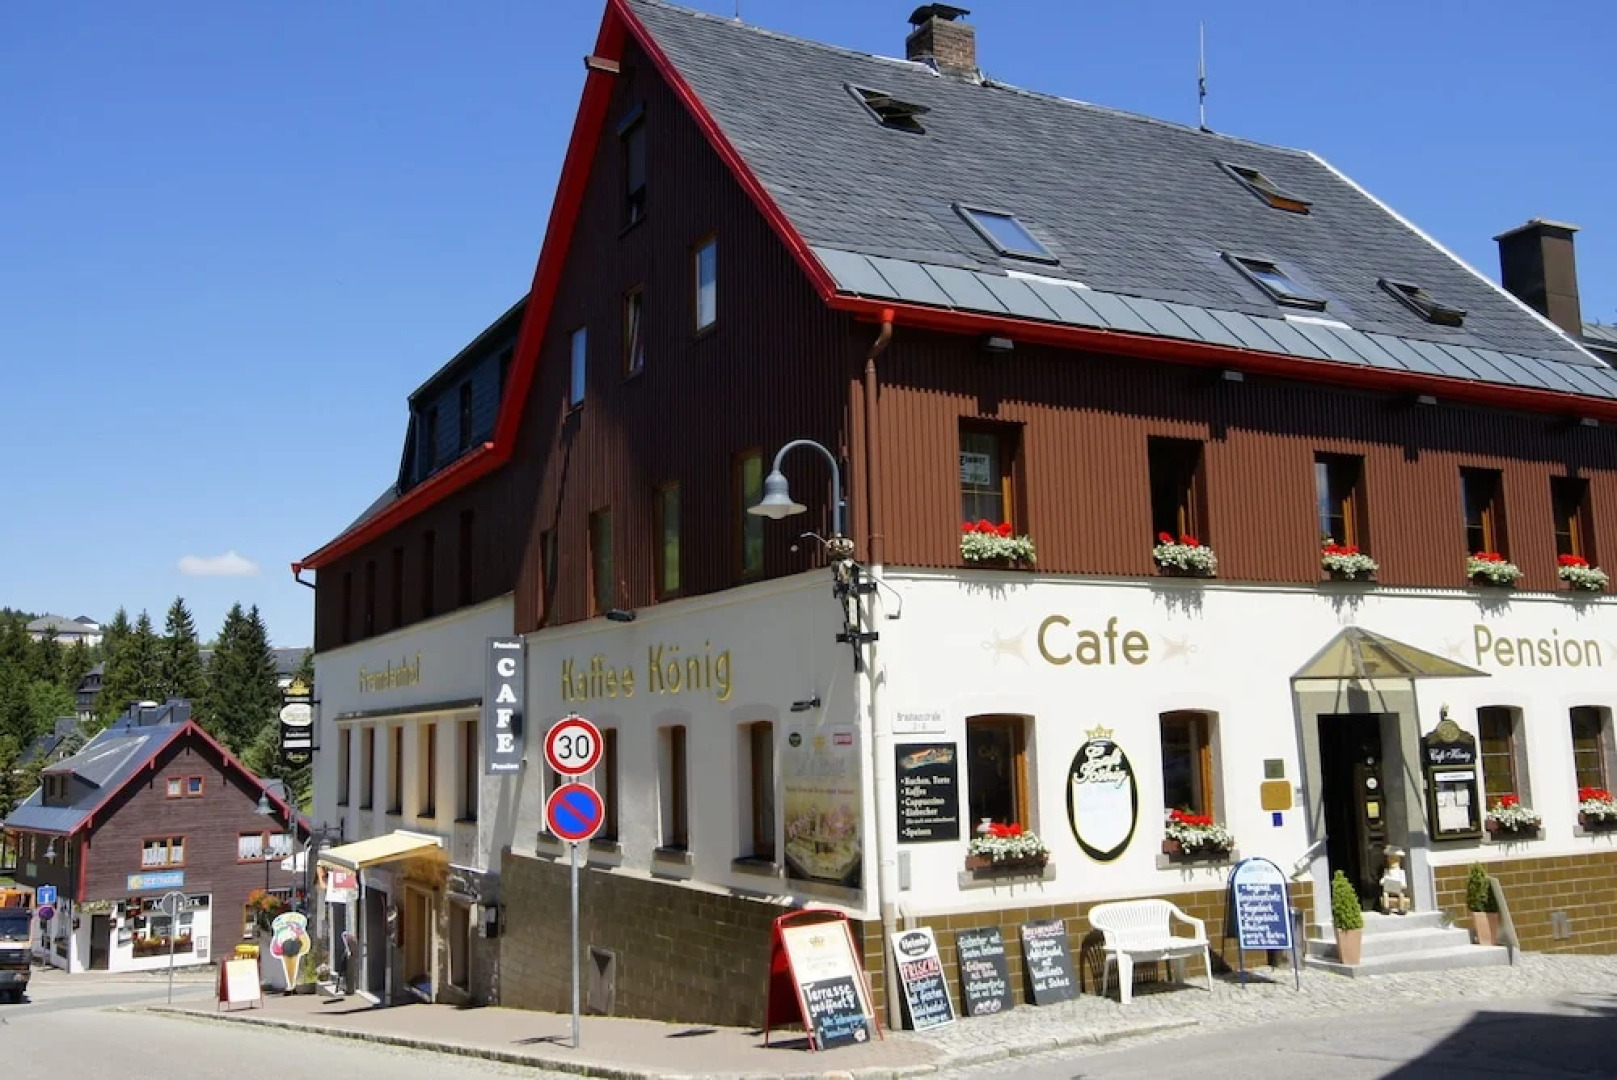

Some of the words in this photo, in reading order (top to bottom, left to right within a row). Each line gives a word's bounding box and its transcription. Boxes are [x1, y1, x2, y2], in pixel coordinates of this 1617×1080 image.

[1038, 614, 1149, 665] Cafe
[1473, 624, 1602, 667] Pension
[562, 654, 635, 701] Kaffee
[648, 640, 731, 701] König
[496, 657, 516, 753] CAFE
[800, 983, 853, 1001] Terrasse
